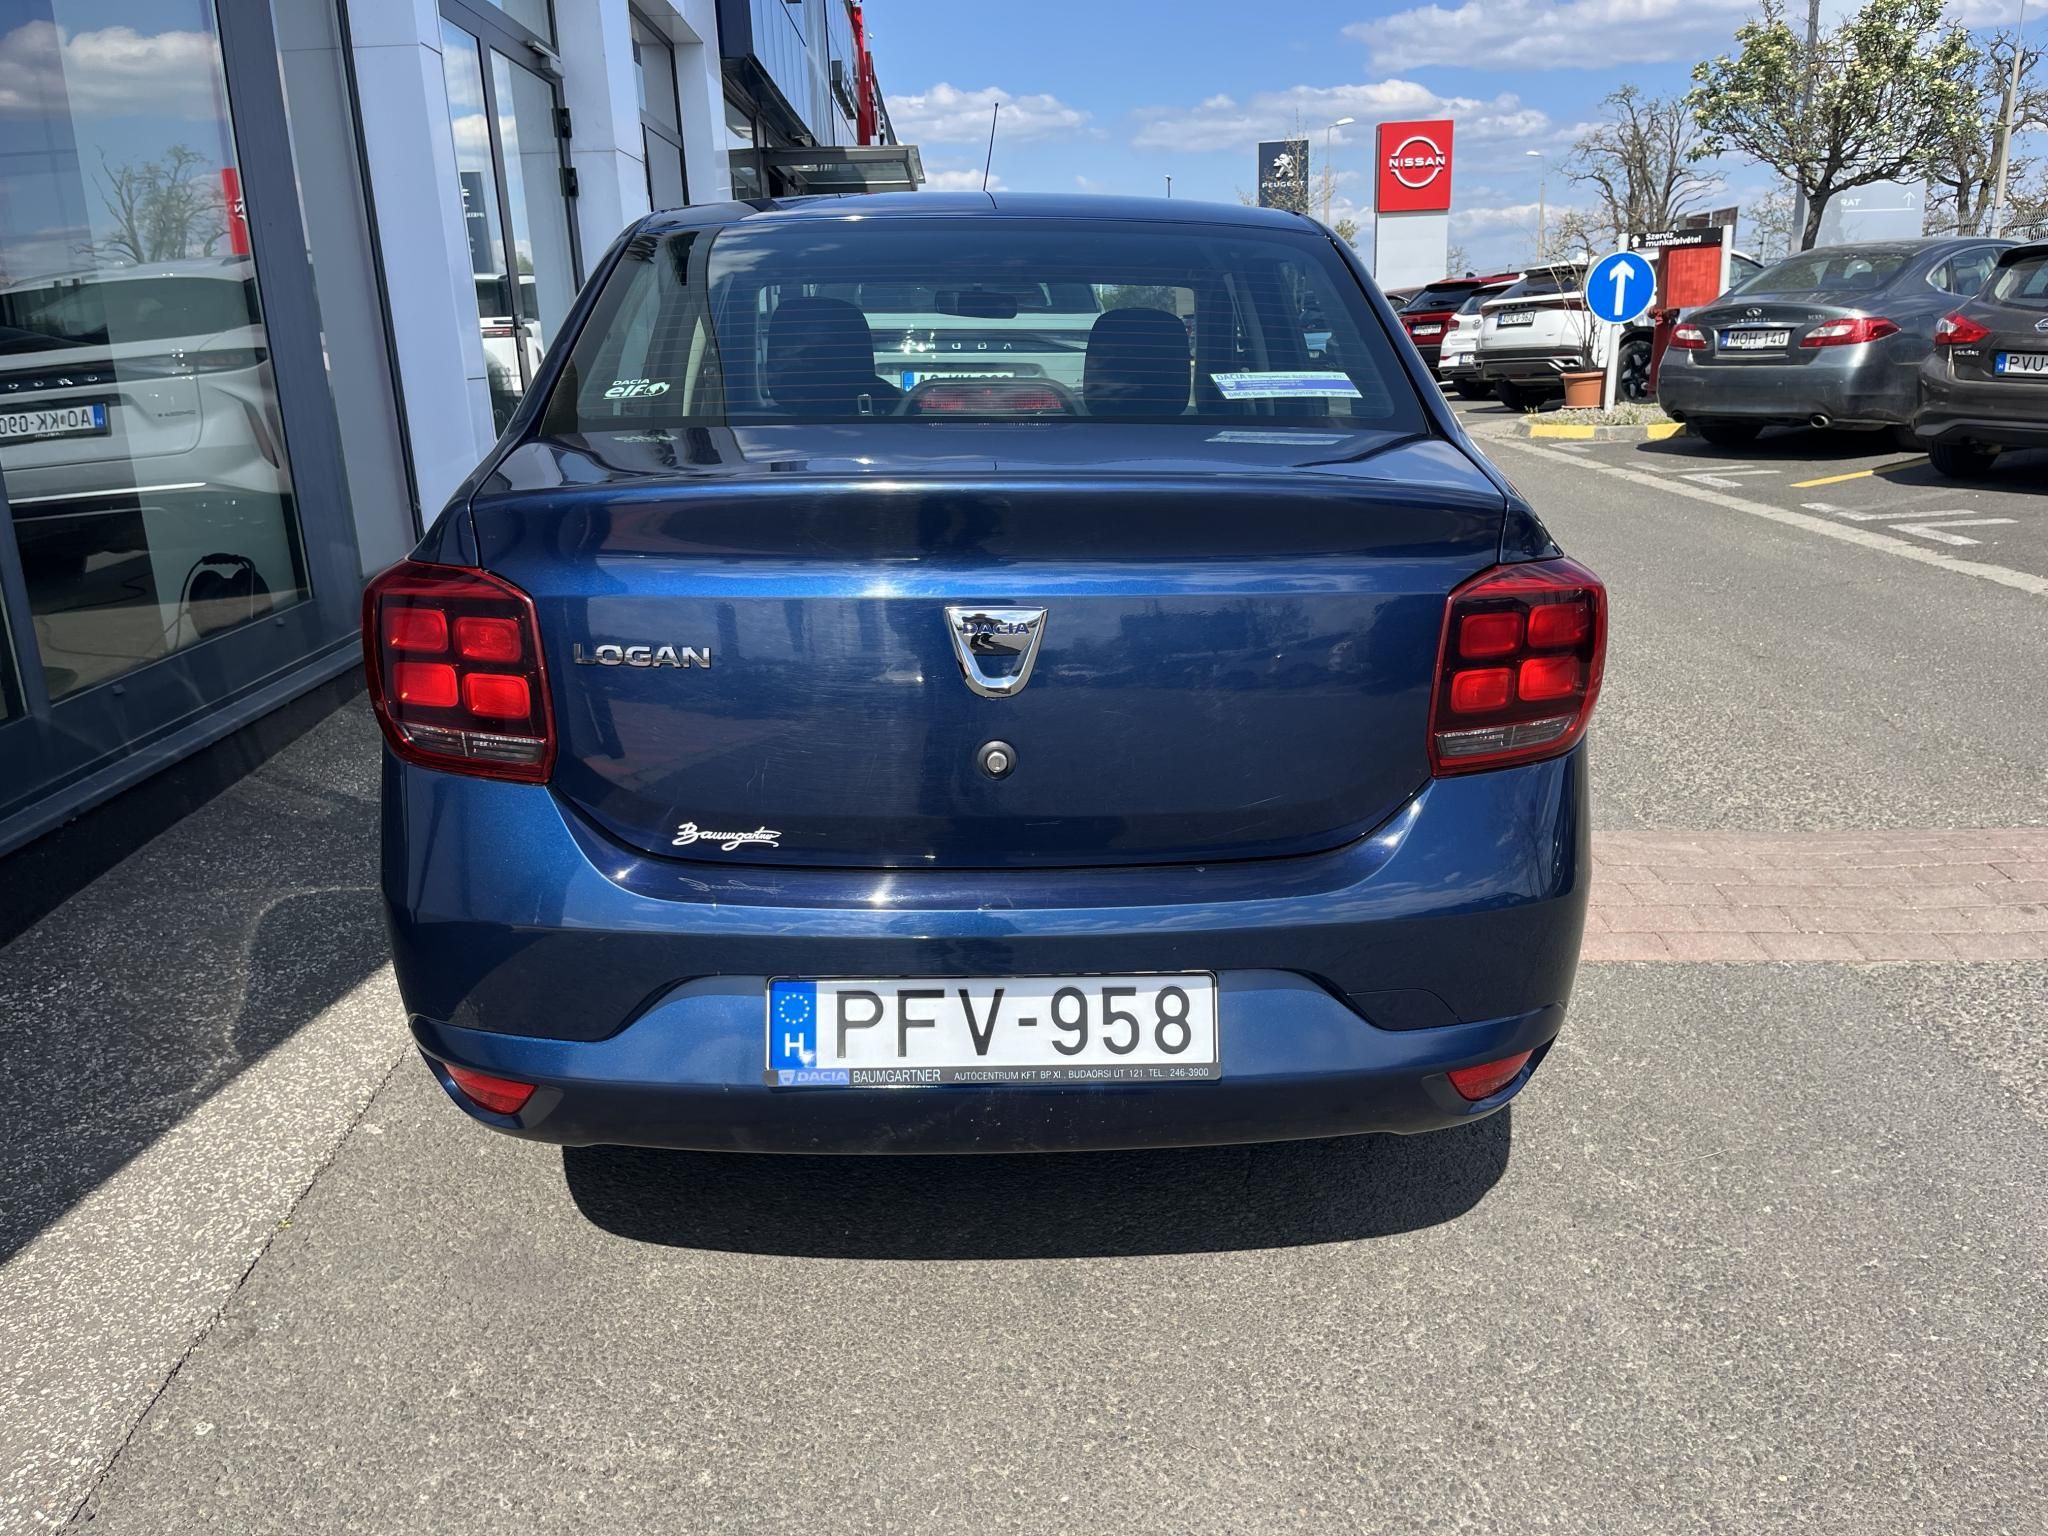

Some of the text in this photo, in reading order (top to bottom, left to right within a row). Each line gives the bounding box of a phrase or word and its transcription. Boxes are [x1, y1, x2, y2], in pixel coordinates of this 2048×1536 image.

[1389, 157, 1445, 169] NISSAN
[1645, 235, 1702, 248] munkafelvétel
[1646, 231, 1674, 241] Szerviz
[1730, 332, 1786, 345] MOH-140
[612, 378, 650, 386] DACIA
[963, 622, 1030, 635] DACIA
[573, 642, 711, 669] LOGAN
[784, 986, 1192, 1058] H PFV-958
[797, 1071, 848, 1082] DACIA
[853, 1069, 941, 1083] BAUMGARTNER
[1169, 1067, 1209, 1078] 246-3900
